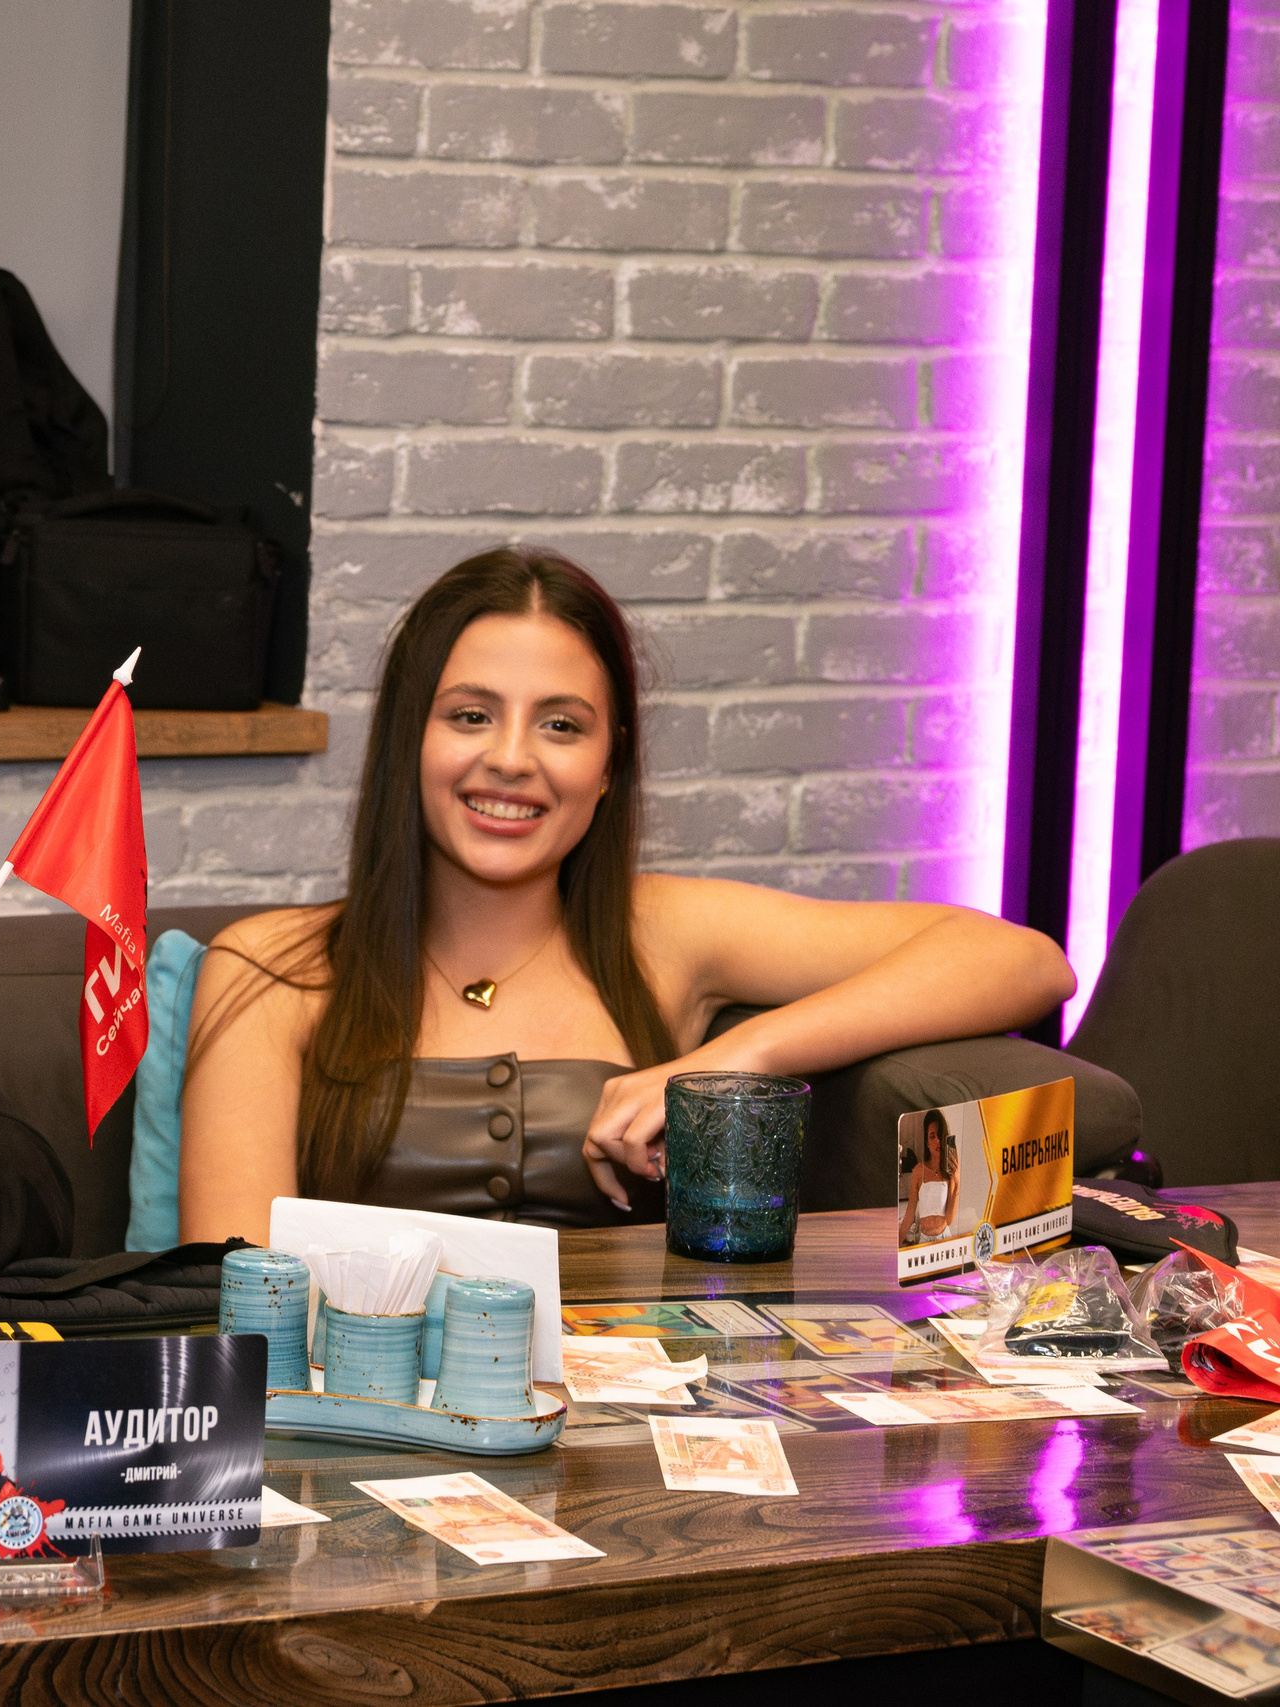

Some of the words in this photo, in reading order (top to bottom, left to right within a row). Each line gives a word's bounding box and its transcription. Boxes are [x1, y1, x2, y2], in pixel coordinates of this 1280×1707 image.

[100, 904, 136, 954] Mafia
[1001, 1129, 1070, 1176] ВАЛЕРЬЯНКА
[1003, 1230, 1022, 1245] MAFIA
[1025, 1224, 1040, 1238] GAME
[1042, 1214, 1069, 1233] UNIVERSE
[907, 1245, 968, 1268] WWW.MAFWG.RU
[83, 1405, 219, 1450] АУДИТОР
[120, 1463, 182, 1484] -ДМИТРИЙ-
[64, 1516, 113, 1530] MAFIA
[122, 1512, 162, 1527] GAME
[172, 1507, 244, 1525] UNIVERSE
